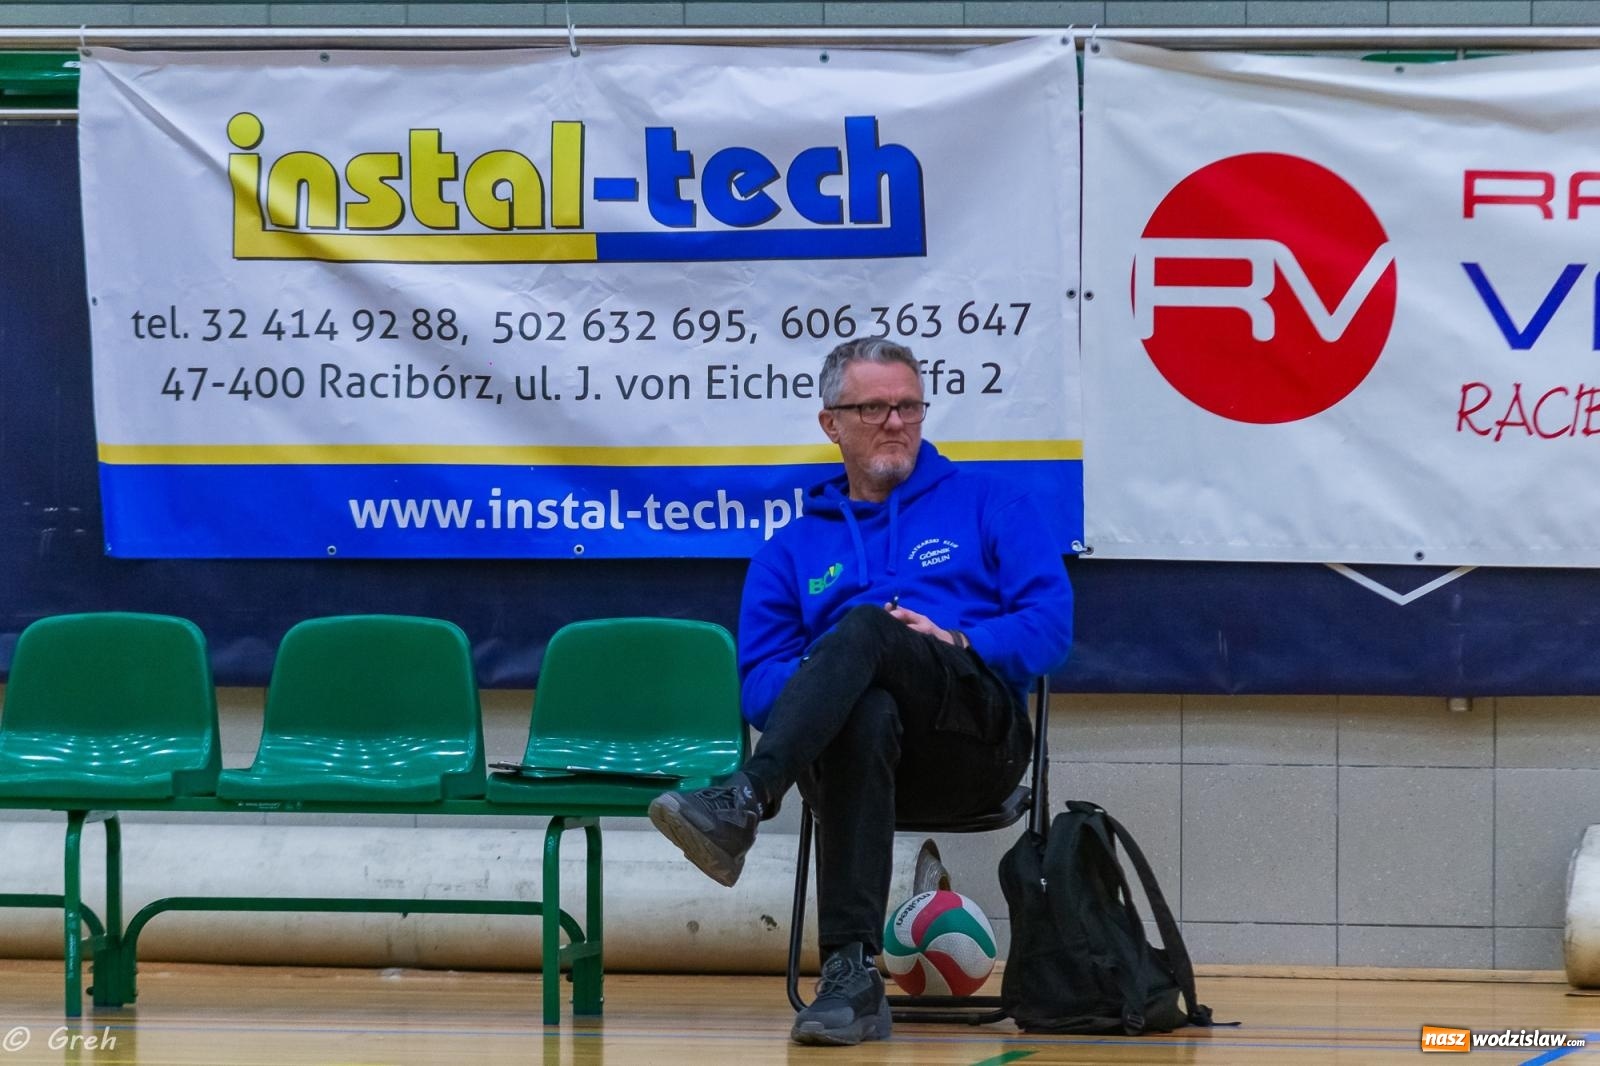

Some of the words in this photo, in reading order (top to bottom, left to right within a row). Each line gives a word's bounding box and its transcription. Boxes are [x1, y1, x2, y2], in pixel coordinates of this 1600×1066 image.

[226, 112, 927, 262] instal-tech
[131, 305, 189, 341] tel.
[201, 308, 249, 342] 32
[261, 308, 340, 342] 414
[351, 308, 401, 342] 92
[410, 307, 469, 346] 88,
[491, 310, 568, 344] 502
[581, 308, 657, 344] 632
[672, 306, 758, 345] 695,
[780, 304, 858, 340] 606
[870, 301, 943, 338] 363
[957, 300, 1032, 336] 647
[1134, 237, 1396, 343] RV
[1460, 262, 1600, 351] V
[160, 365, 306, 402] 47-400
[319, 363, 504, 406] Racibórz,
[514, 364, 562, 402] ul.
[574, 364, 602, 402] J.
[614, 374, 691, 402] von
[980, 361, 1004, 395] 2
[348, 486, 804, 542] www.instal-tech.pl
